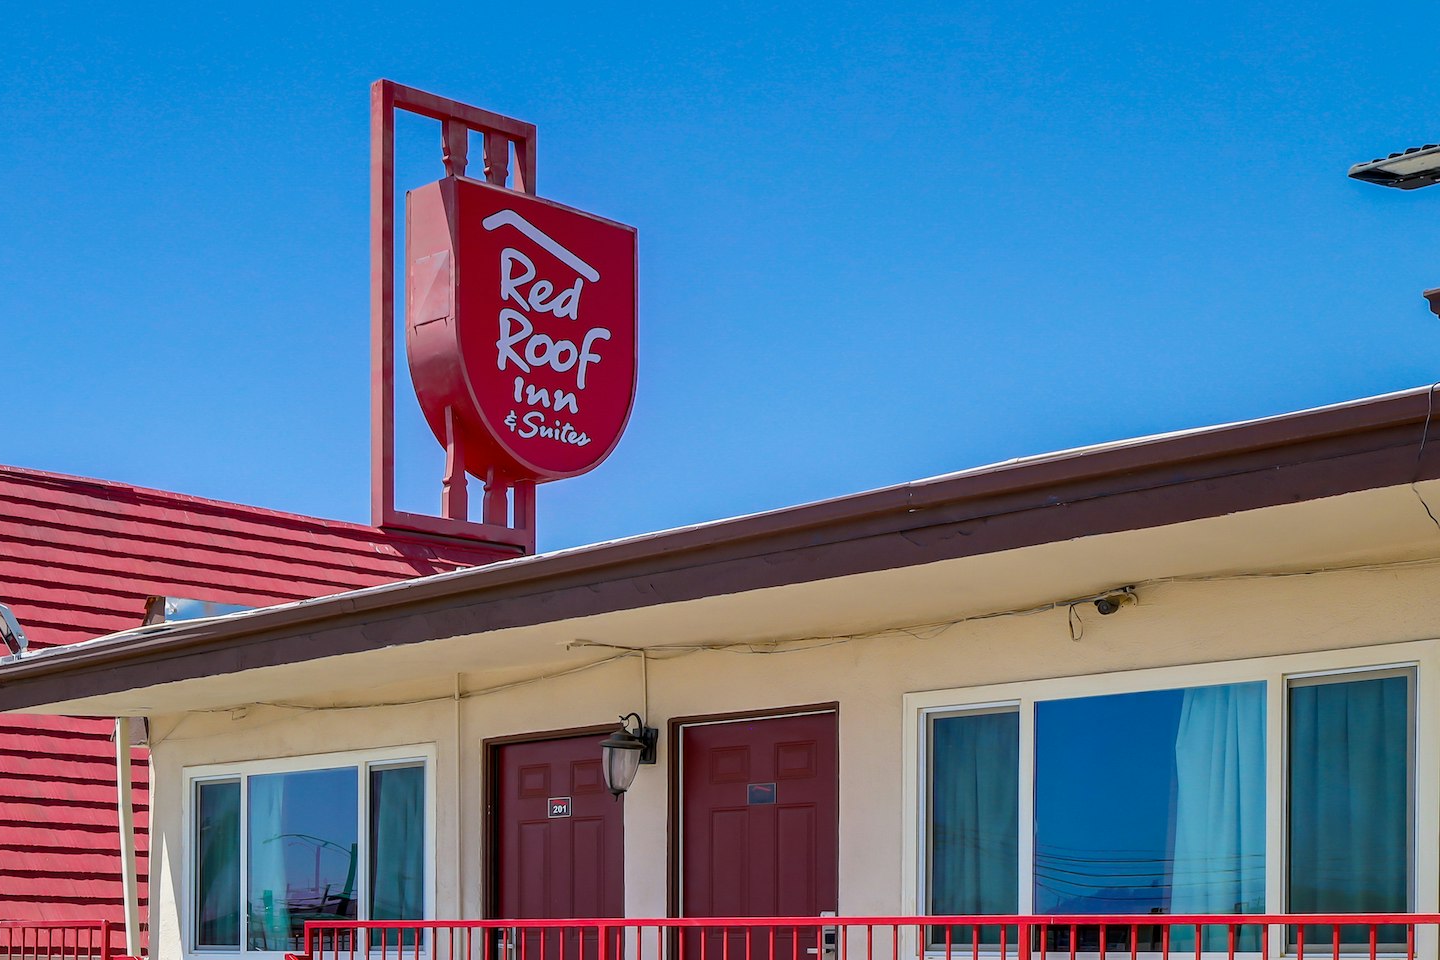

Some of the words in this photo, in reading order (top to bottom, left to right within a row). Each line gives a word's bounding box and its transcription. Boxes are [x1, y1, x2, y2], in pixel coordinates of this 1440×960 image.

[500, 248, 583, 320] Red
[496, 307, 611, 389] Roof
[514, 376, 579, 414] Inn
[504, 410, 517, 432] &
[518, 411, 591, 447] Suites
[552, 805, 567, 813] 201
